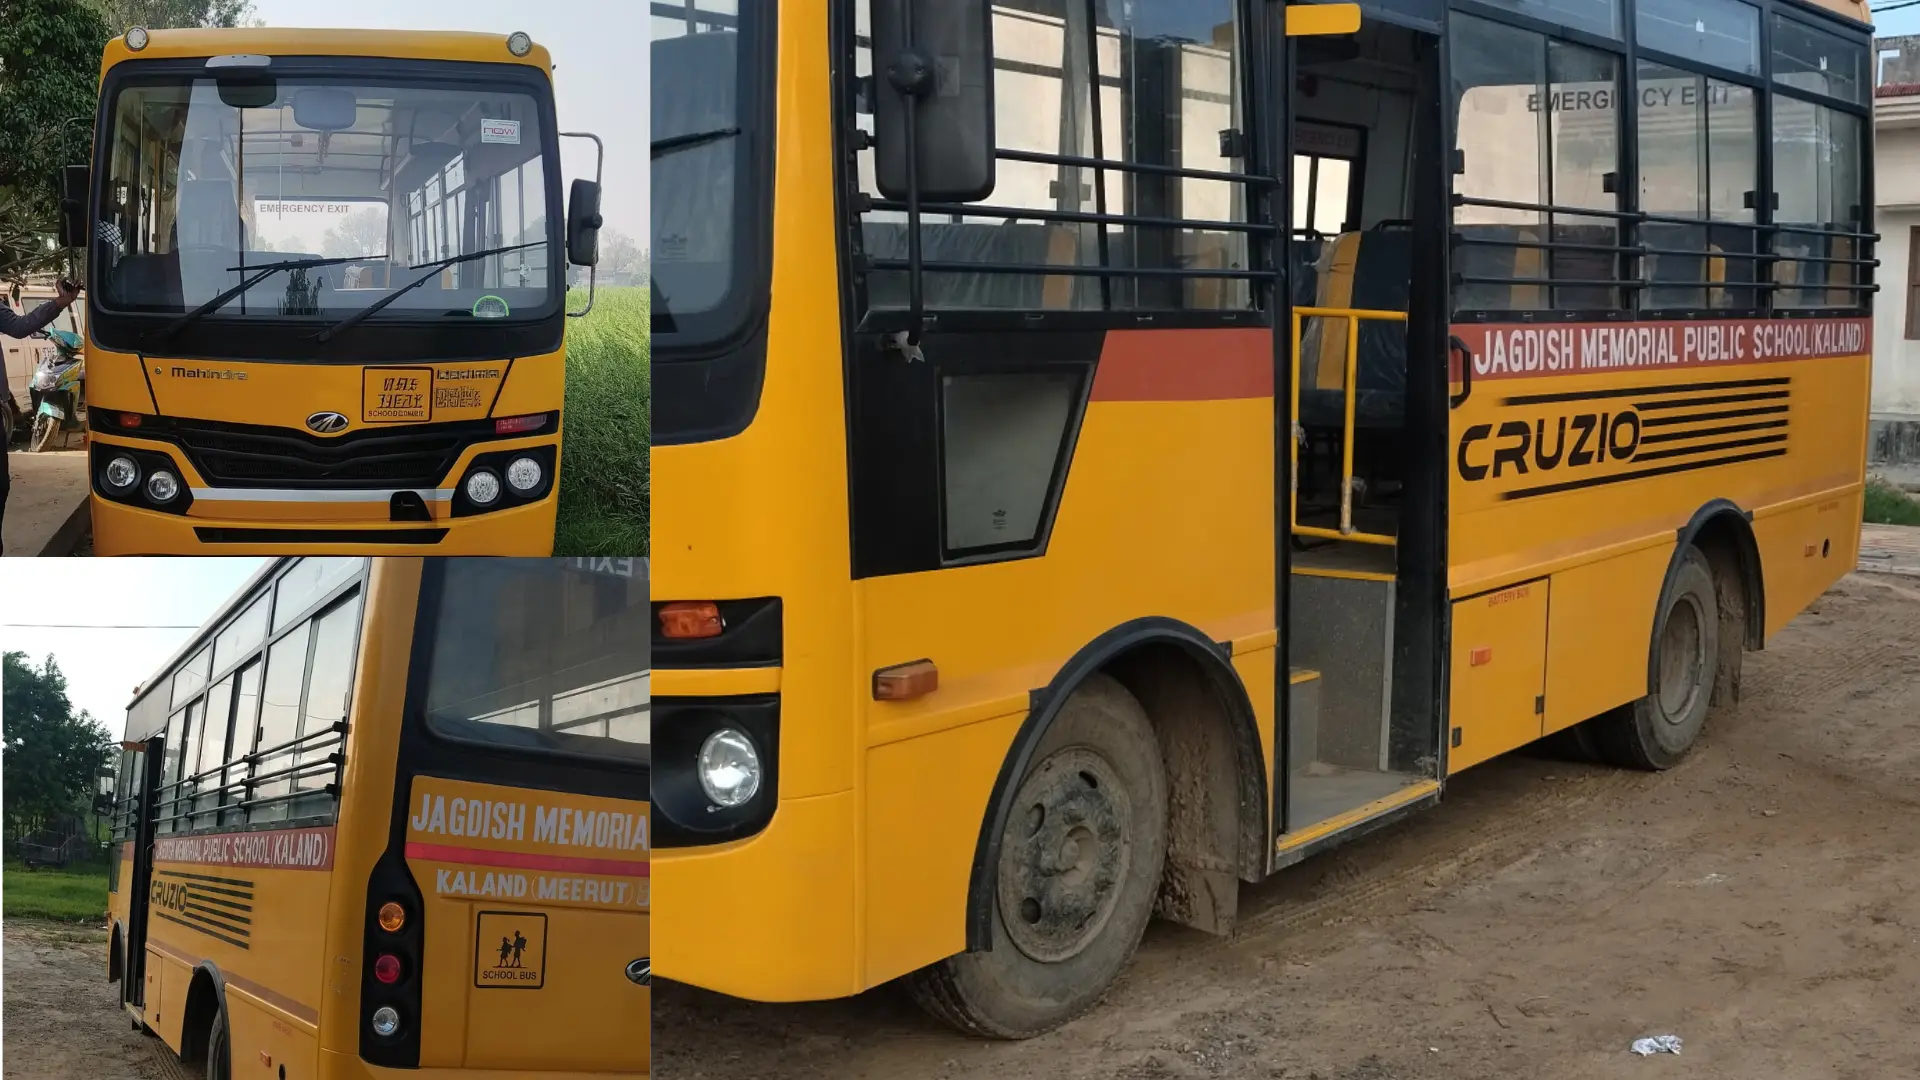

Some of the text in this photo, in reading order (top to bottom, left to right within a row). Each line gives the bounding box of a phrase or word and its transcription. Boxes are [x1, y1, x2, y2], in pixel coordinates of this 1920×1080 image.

[1527, 86, 1671, 112] EMERGCY
[260, 204, 350, 213] EMERGENCY EXIT
[1474, 328, 1574, 375] JAGDISH
[1580, 327, 1679, 369] MEMORIAL
[1683, 325, 1746, 362] PUBLIC
[1457, 410, 1640, 482] CRUZIO
[412, 793, 650, 851] JAGDISH MEMORIA
[203, 837, 231, 863] PUBLIC
[151, 879, 188, 913] CRUZIO
[436, 868, 528, 897] KALAND
[482, 970, 537, 981] SCHOOL BUS
